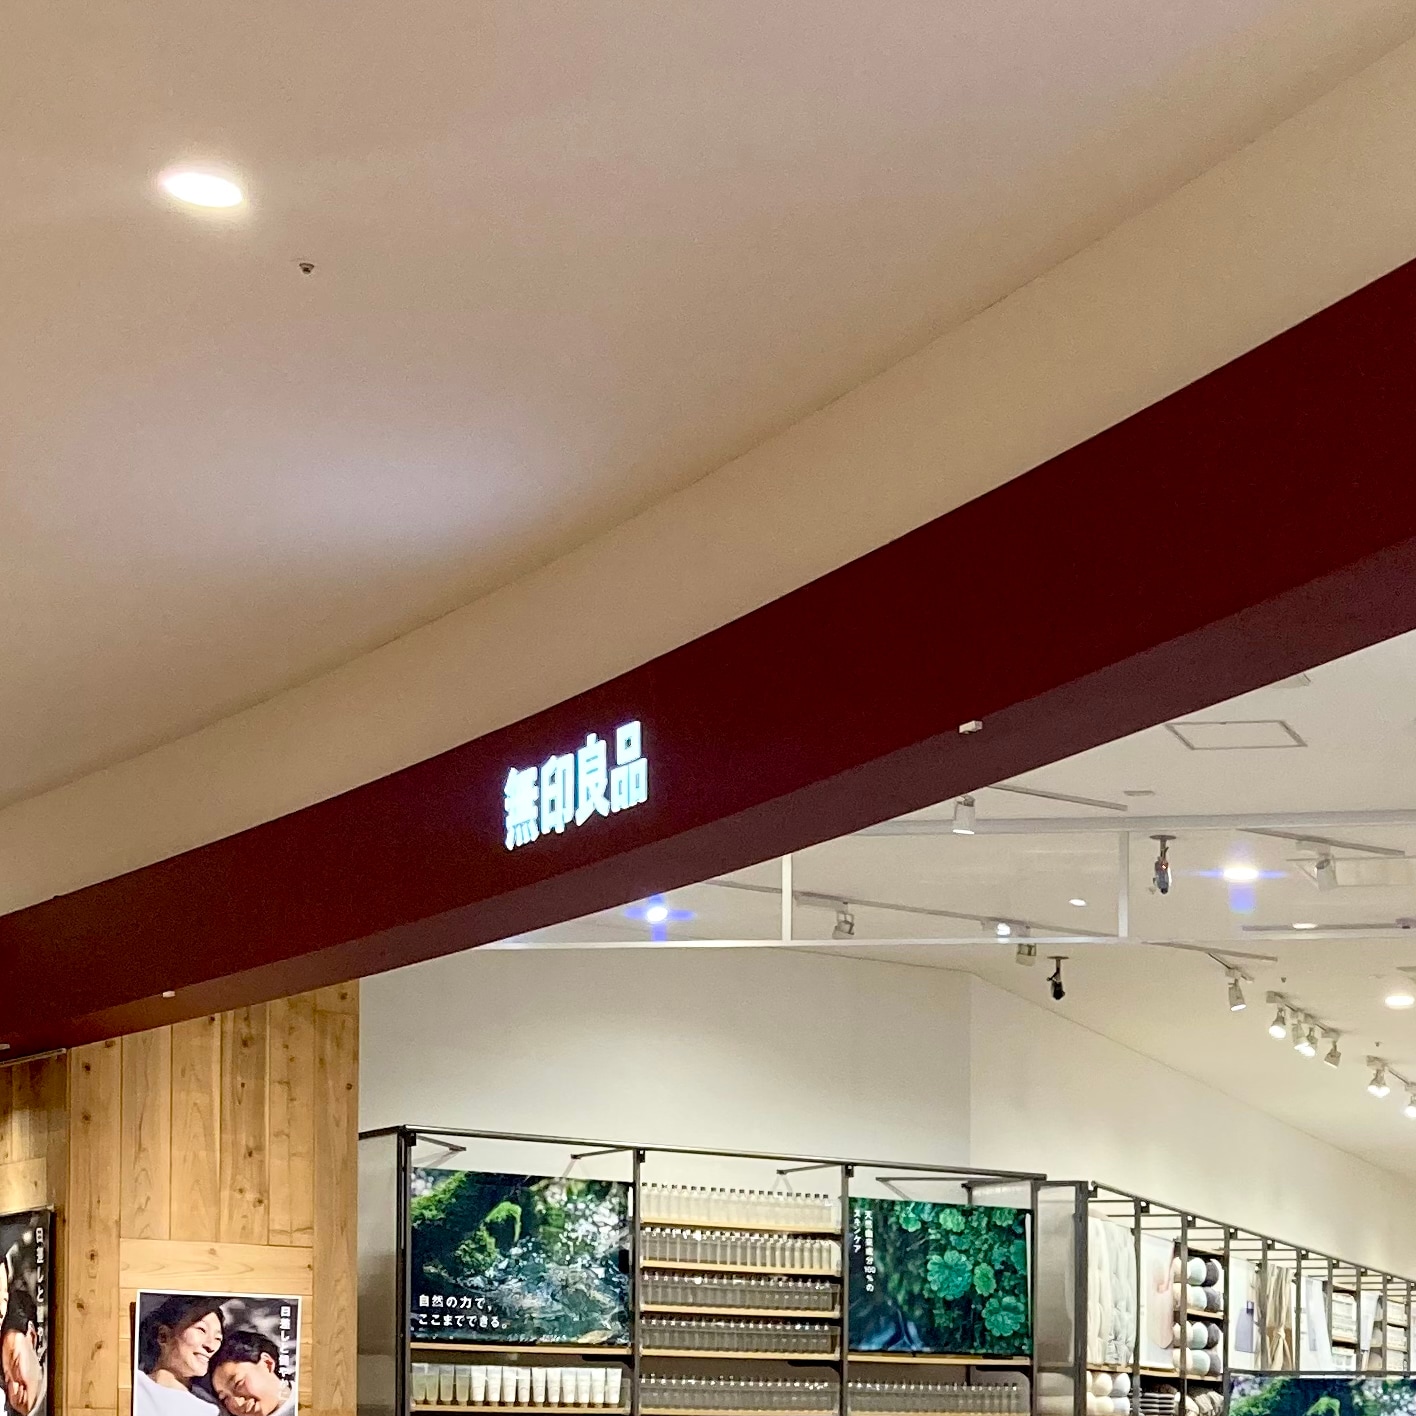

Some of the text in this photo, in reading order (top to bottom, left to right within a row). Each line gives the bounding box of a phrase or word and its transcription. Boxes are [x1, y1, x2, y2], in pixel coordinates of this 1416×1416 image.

[504, 720, 648, 850] 無印良品
[853, 1209, 862, 1253] スキンケア
